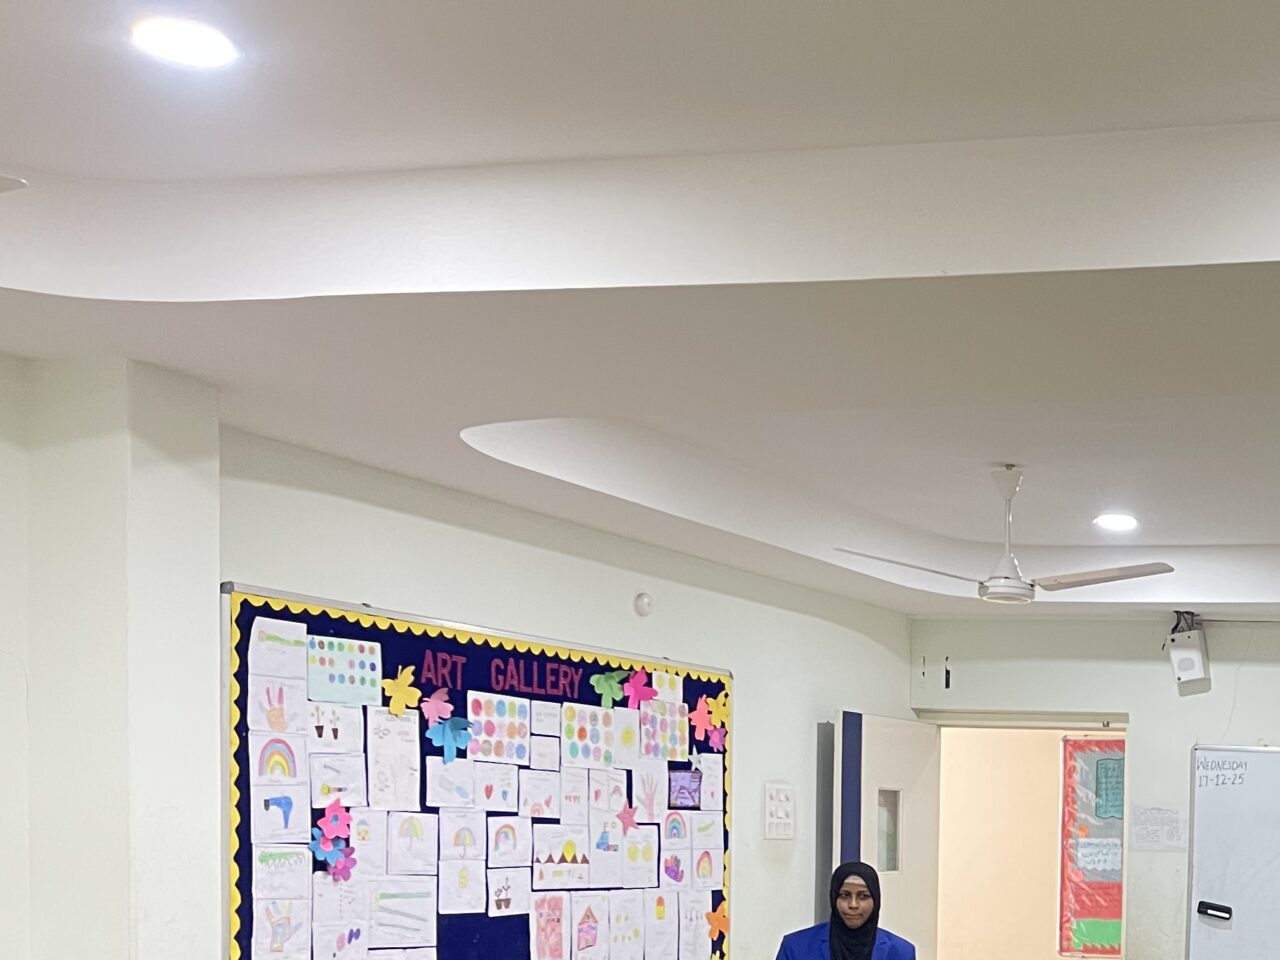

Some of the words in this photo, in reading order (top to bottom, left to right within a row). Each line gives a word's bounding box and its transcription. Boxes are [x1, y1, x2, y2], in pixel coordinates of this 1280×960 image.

[421, 649, 467, 691] ART
[490, 657, 583, 699] GALLERY
[1196, 757, 1248, 771] WEDNESDAY
[1198, 773, 1245, 787] 17-12-25
